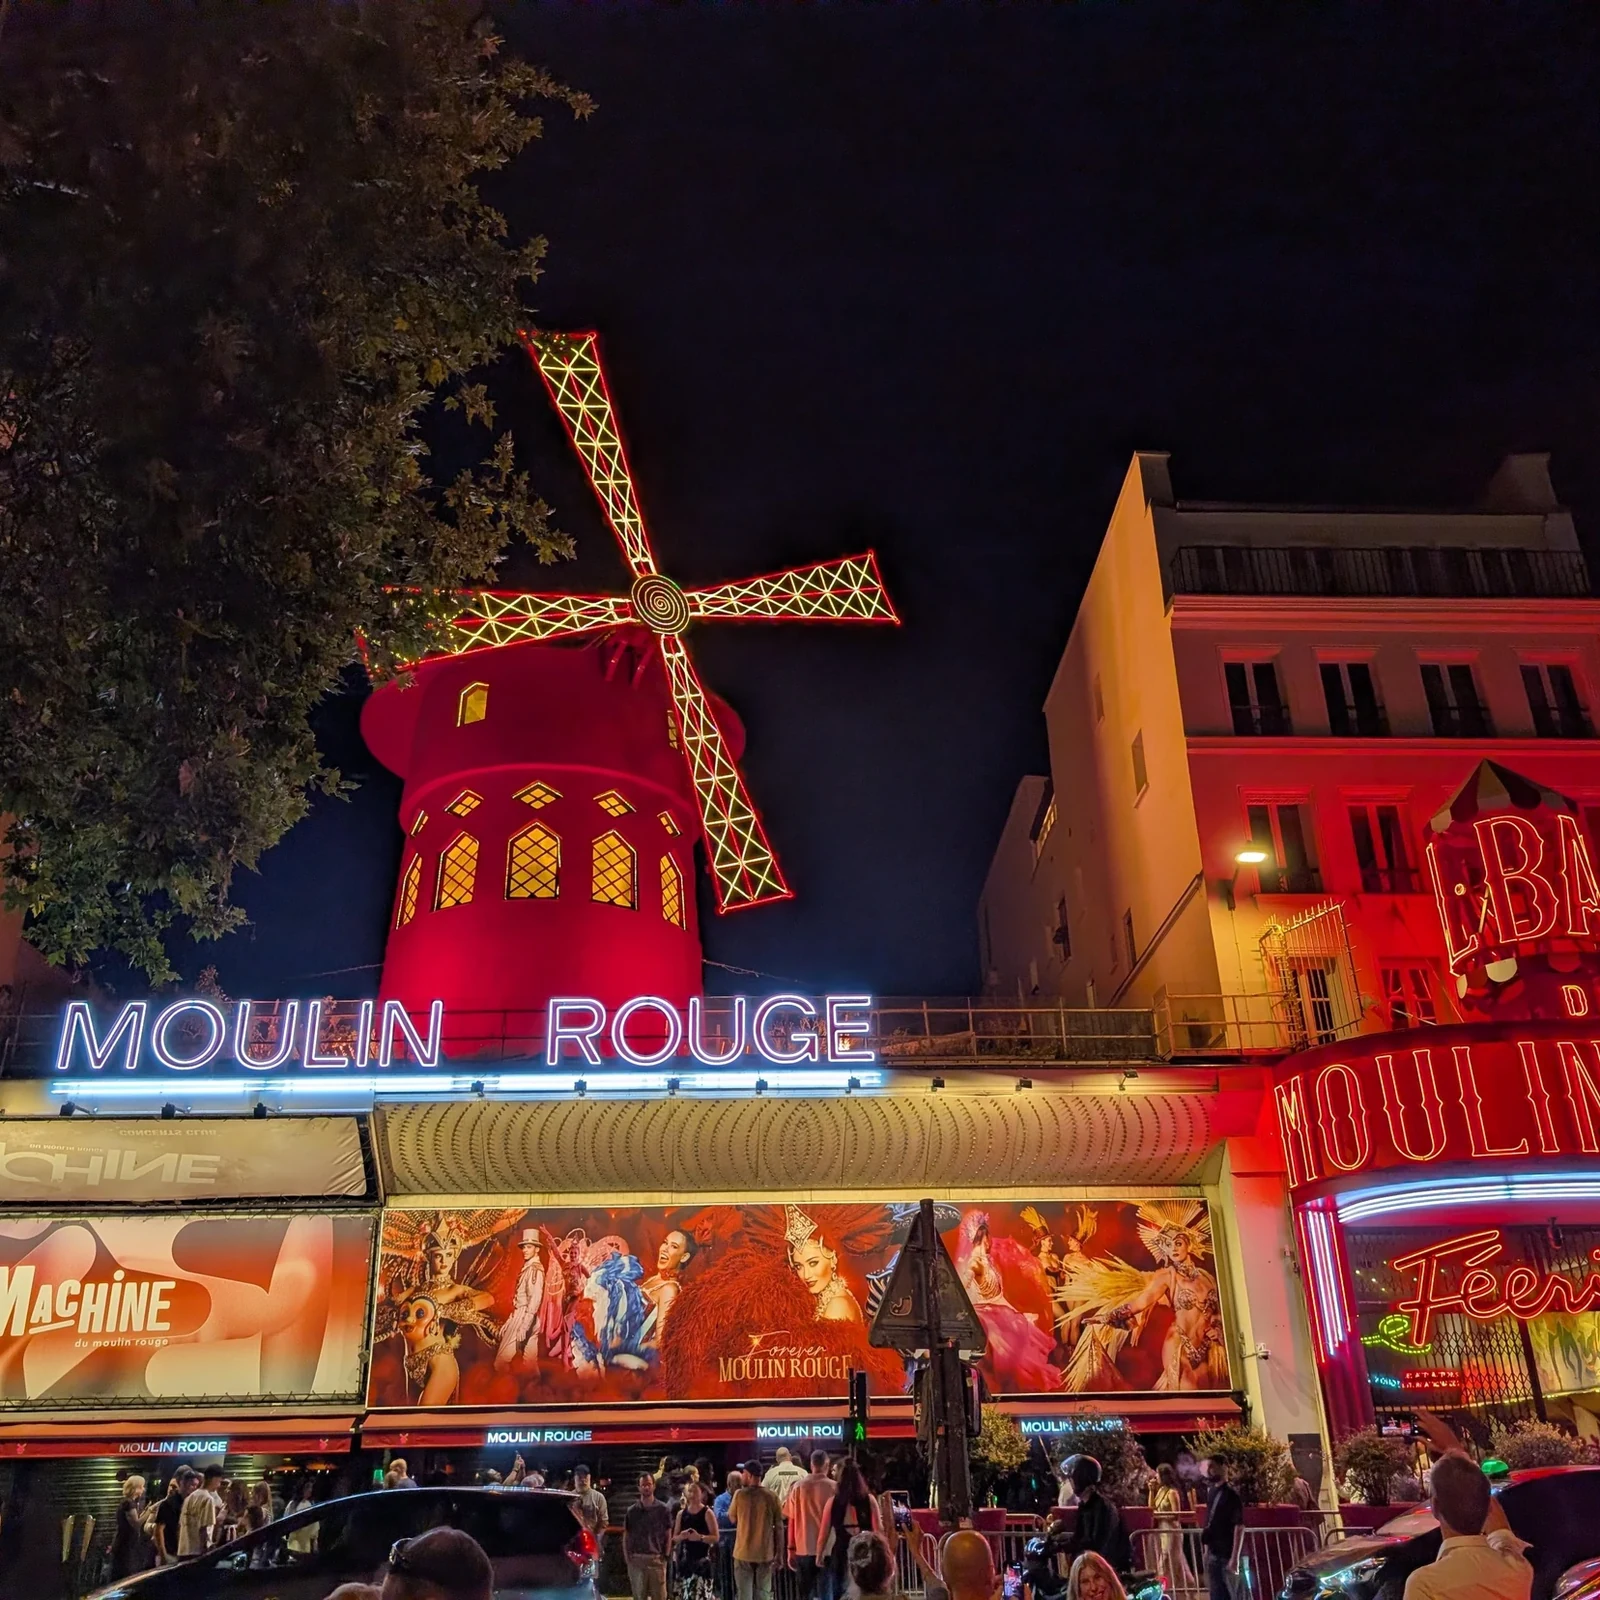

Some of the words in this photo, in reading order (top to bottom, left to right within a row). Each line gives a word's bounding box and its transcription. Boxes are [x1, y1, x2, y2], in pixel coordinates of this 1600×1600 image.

[56, 998, 444, 1071] MOULIN
[546, 994, 876, 1067] ROUGE
[1273, 1041, 1600, 1188] MOULIN
[74, 1338, 89, 1348] du
[92, 1337, 132, 1347] moulin
[135, 1338, 169, 1348] rouge
[738, 1330, 827, 1366] Forever
[718, 1356, 786, 1383] MOULIN
[790, 1354, 852, 1380] ROUGE
[757, 1426, 809, 1438] MOULIN
[812, 1425, 842, 1437] ROU
[1021, 1420, 1073, 1433] MOULIN
[487, 1431, 541, 1443] MOULIN
[544, 1430, 593, 1442] ROUGE
[118, 1442, 174, 1453] MOULIN
[177, 1441, 228, 1452] ROUGE
